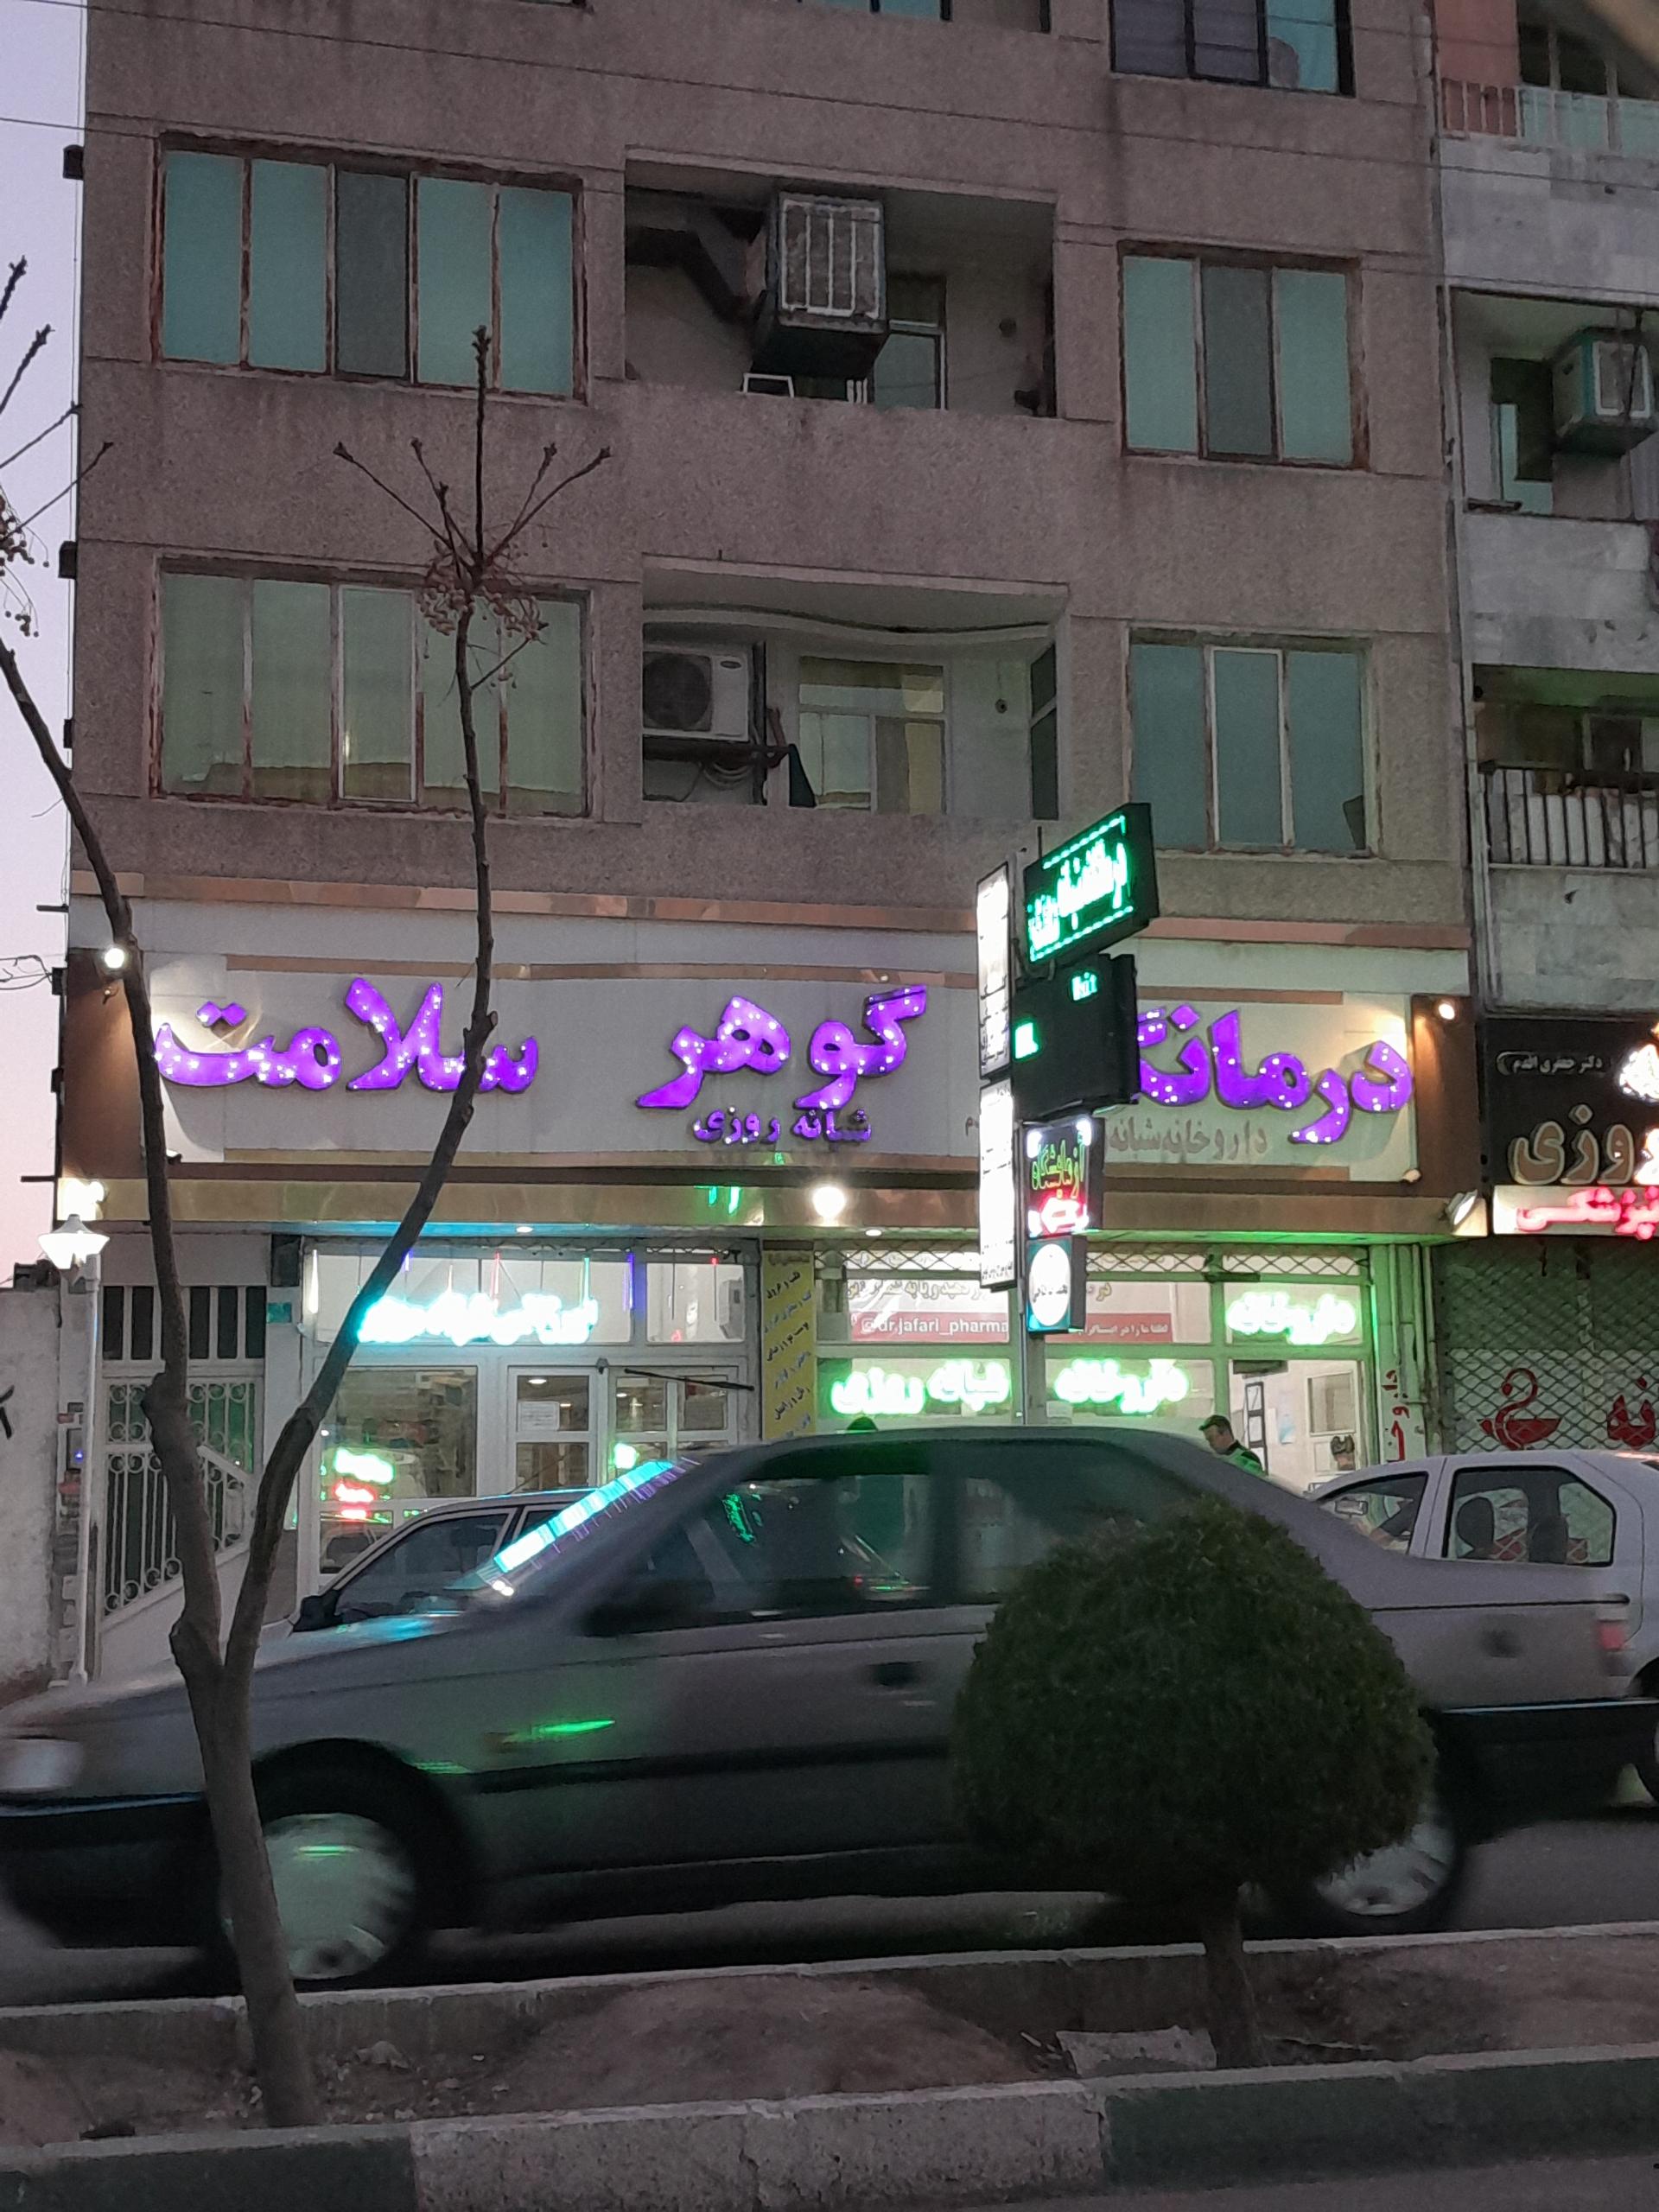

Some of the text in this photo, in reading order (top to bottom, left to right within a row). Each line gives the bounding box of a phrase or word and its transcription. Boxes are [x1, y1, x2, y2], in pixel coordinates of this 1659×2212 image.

[155, 977, 538, 1094] سلامت
[635, 985, 926, 1109] گوهر
[693, 1109, 779, 1143] روزی
